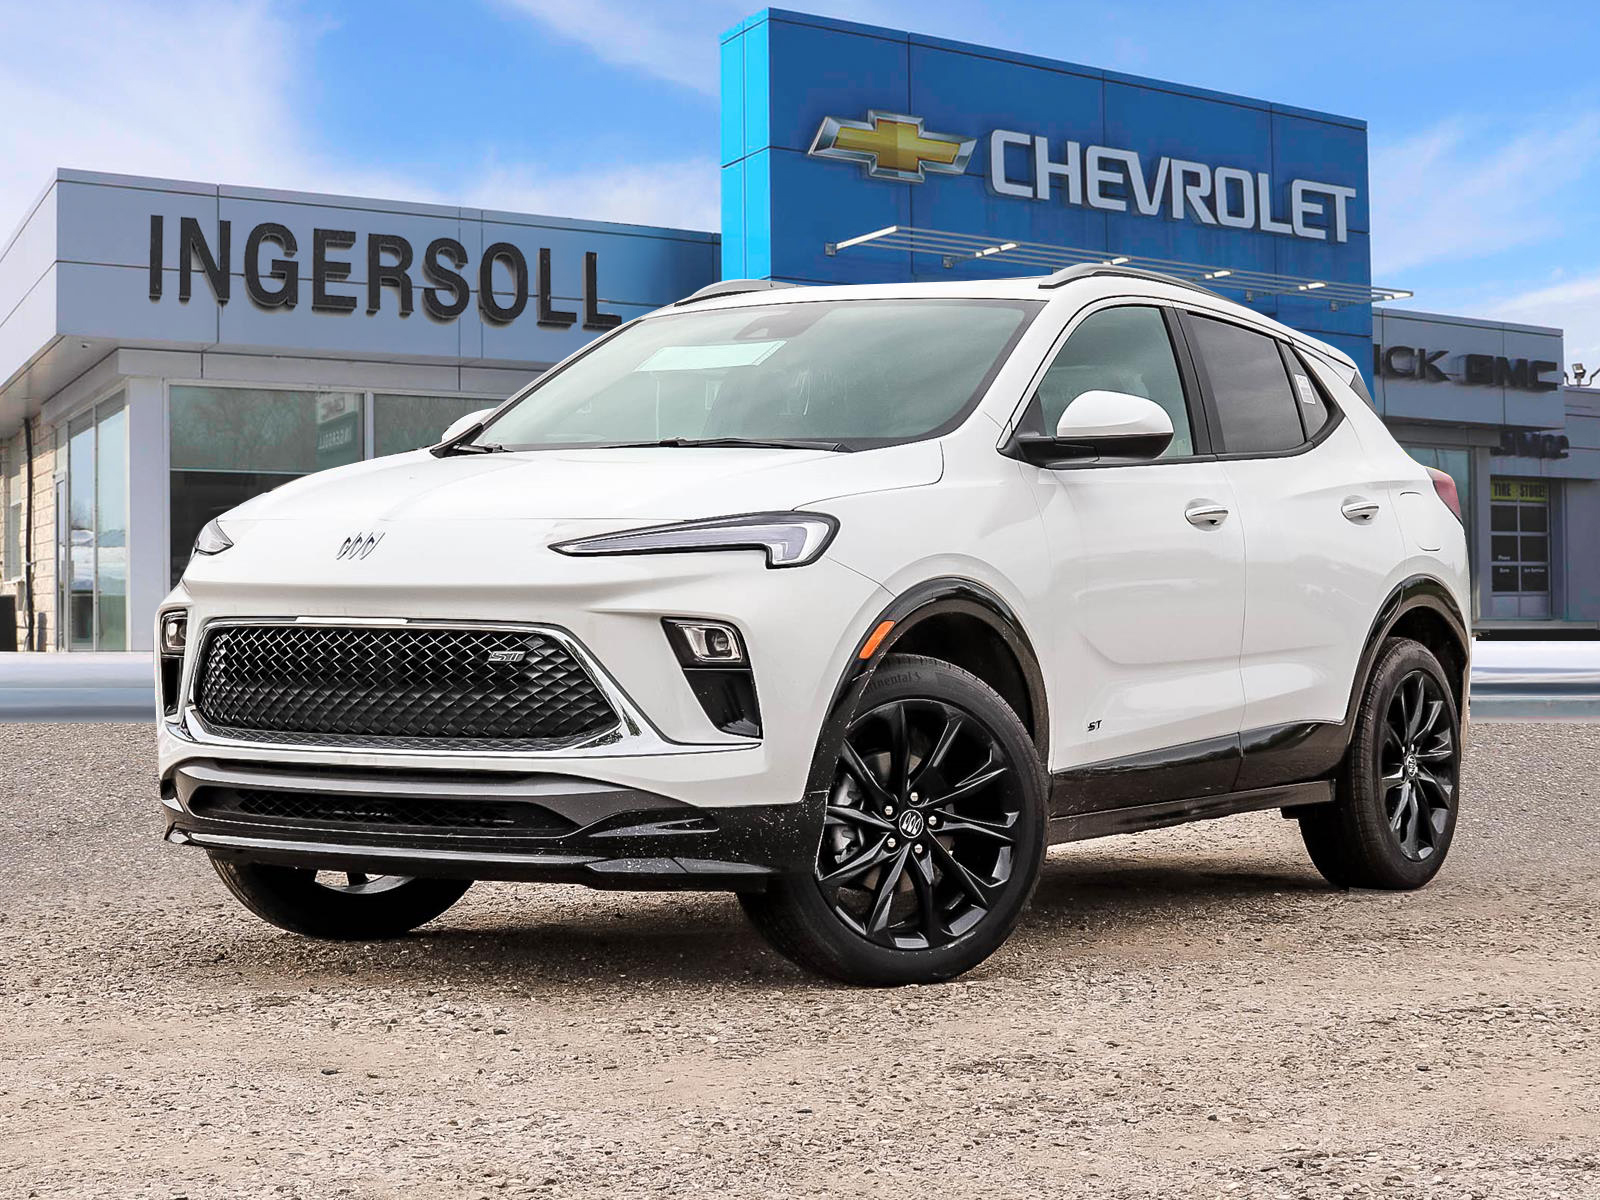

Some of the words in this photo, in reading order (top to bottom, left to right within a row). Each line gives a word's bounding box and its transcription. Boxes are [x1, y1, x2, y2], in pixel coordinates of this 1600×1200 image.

[991, 129, 1357, 243] CHEVROLET
[149, 214, 622, 330] INGERSOLL
[1087, 719, 1103, 732] ST
